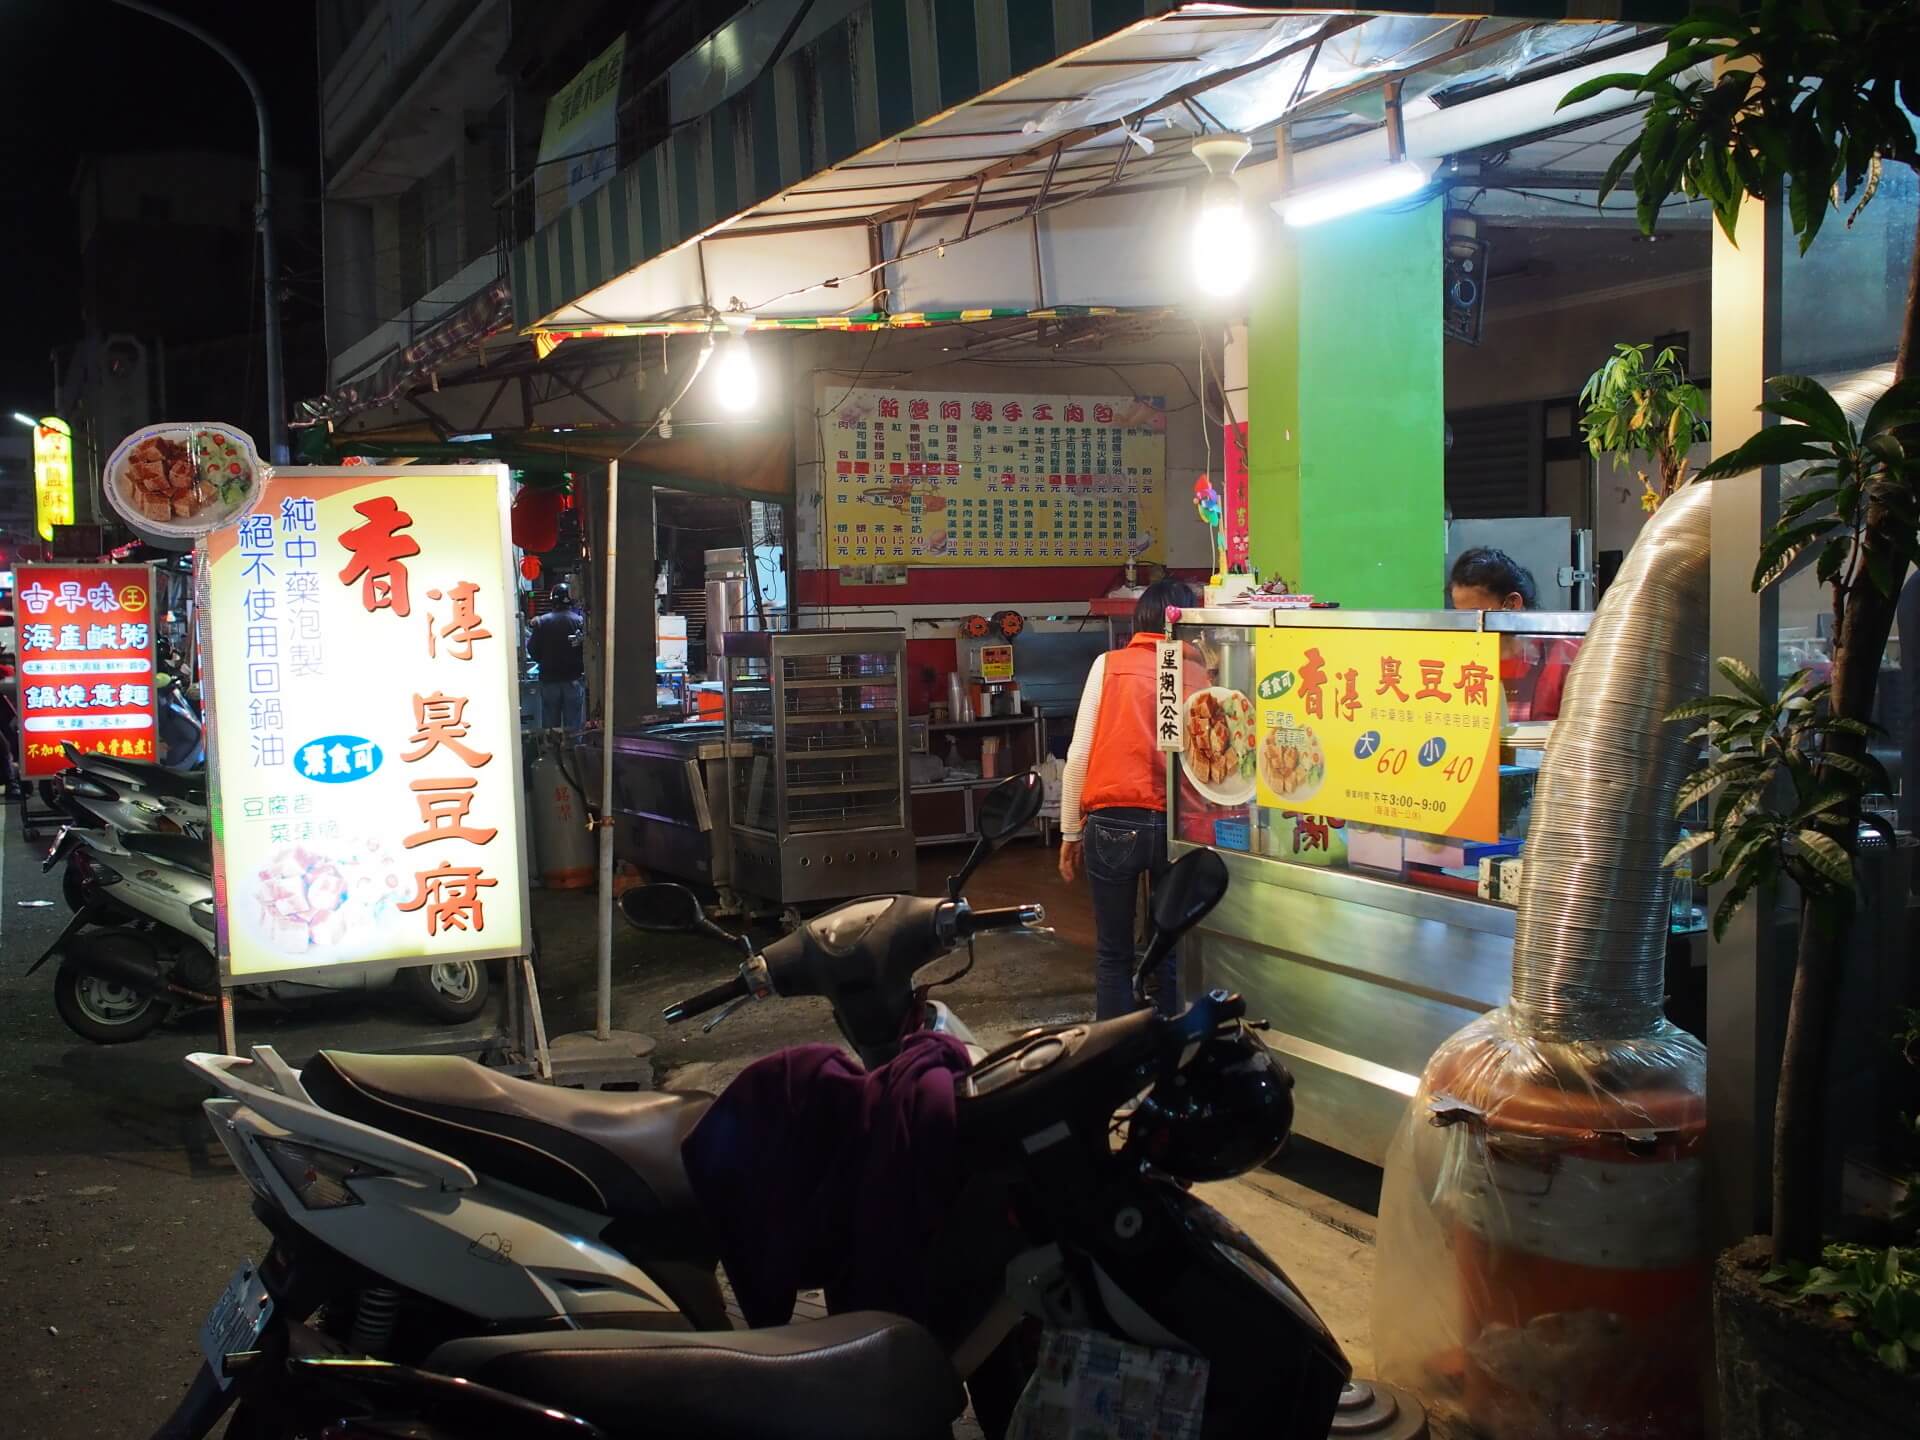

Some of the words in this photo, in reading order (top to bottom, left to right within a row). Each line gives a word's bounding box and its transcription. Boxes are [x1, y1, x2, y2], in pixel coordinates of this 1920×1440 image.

[281, 497, 326, 678] 純中藥泡製
[22, 623, 149, 652] 海產鹹粥
[238, 513, 285, 769] 絕不使用回鍋油
[25, 683, 150, 710] 鍋燒意麵
[1261, 671, 1291, 698] 素食可
[302, 742, 376, 775] 素食可
[1359, 735, 1377, 756] 大
[1376, 748, 1408, 776] 60
[1422, 740, 1443, 762] 小
[1442, 755, 1474, 783] 40
